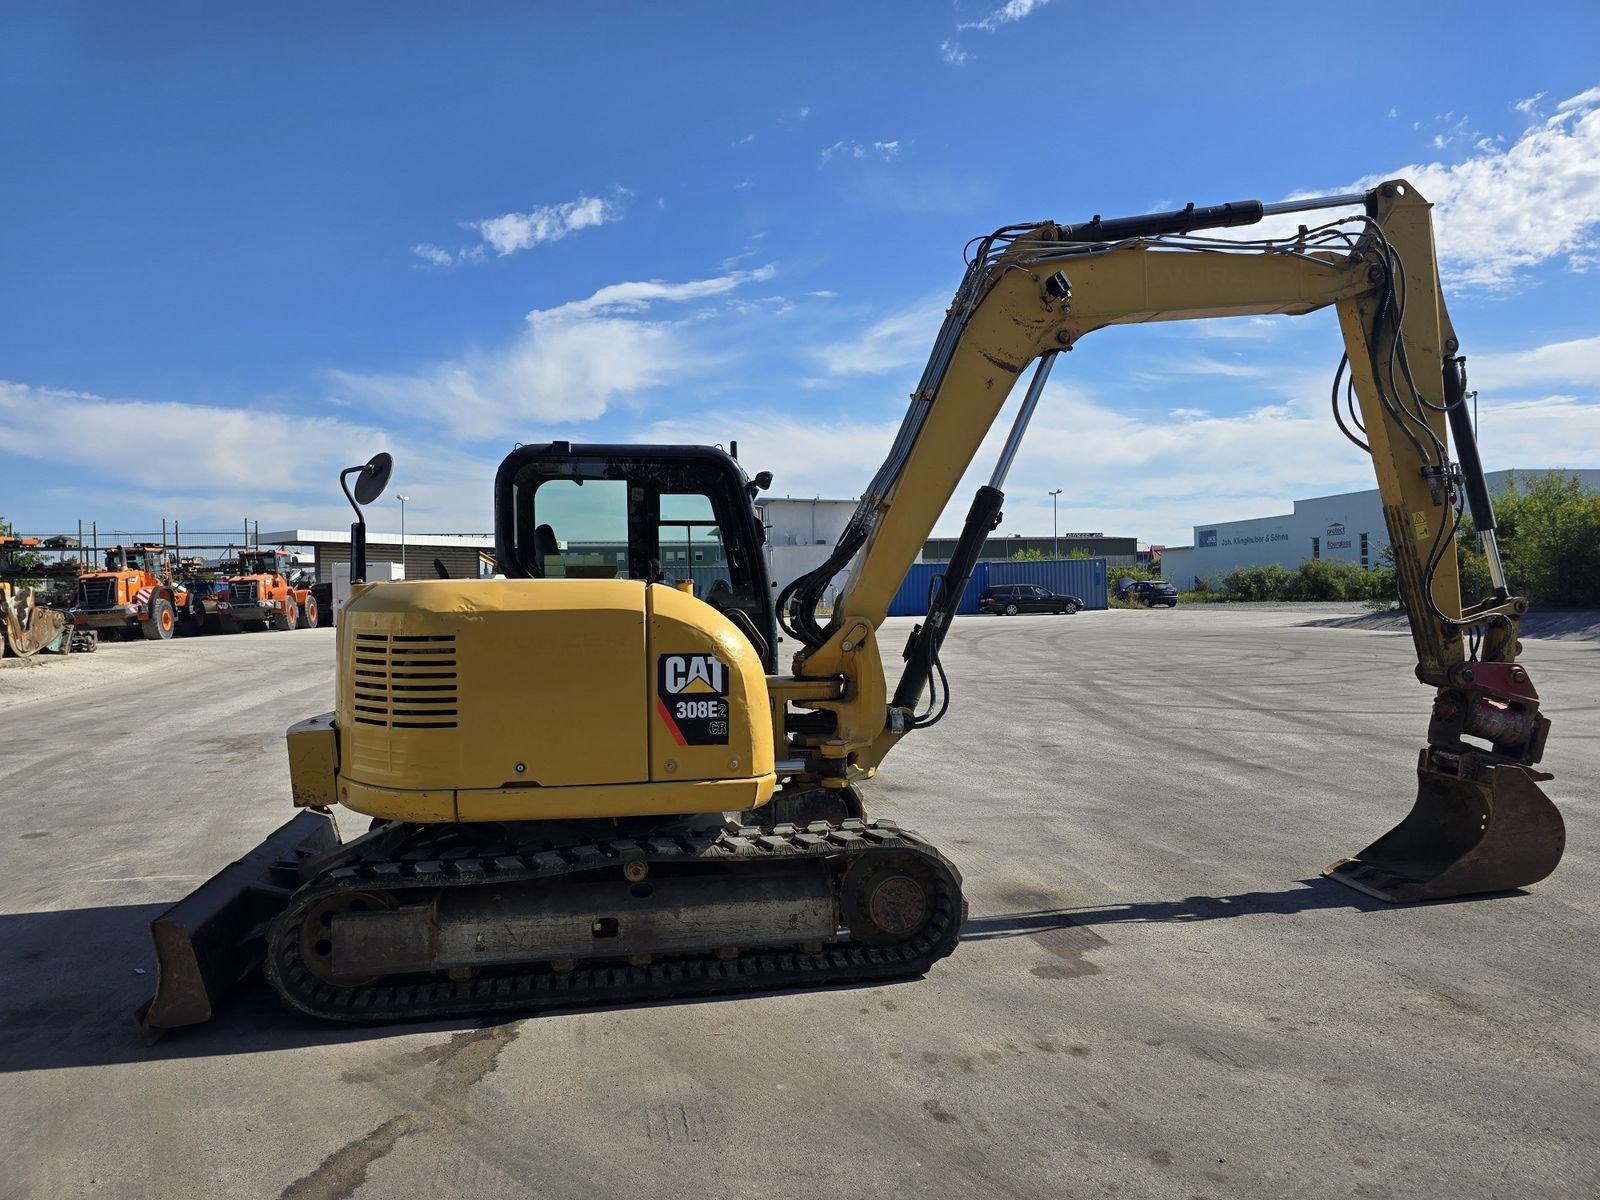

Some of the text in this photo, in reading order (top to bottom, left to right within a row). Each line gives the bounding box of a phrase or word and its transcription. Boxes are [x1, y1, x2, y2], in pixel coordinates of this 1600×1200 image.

[1265, 533, 1270, 542] &
[665, 655, 723, 694] CAT
[676, 701, 727, 719] 308E2
[709, 720, 727, 735] CR
